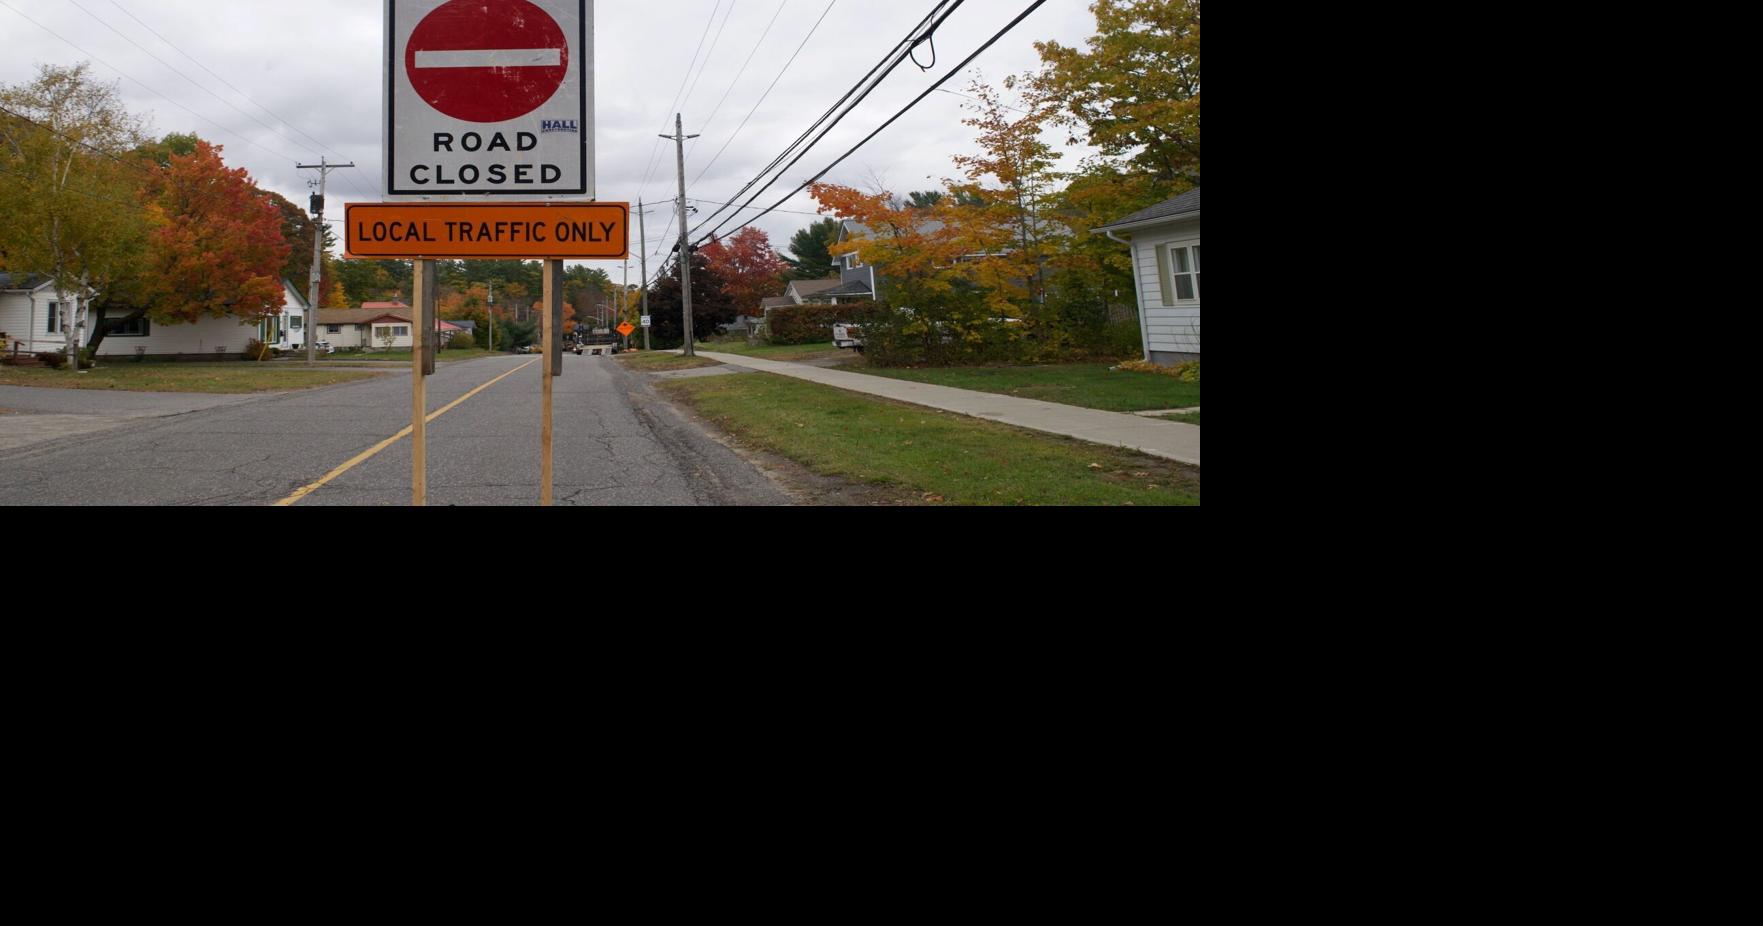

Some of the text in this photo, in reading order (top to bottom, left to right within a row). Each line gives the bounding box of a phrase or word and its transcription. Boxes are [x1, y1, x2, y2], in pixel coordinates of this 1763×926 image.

[542, 120, 577, 129] HALL
[434, 132, 538, 152] ROAD
[410, 164, 562, 185] CLOSED
[358, 221, 616, 242] LOCAL TRAFFIC ONLY
